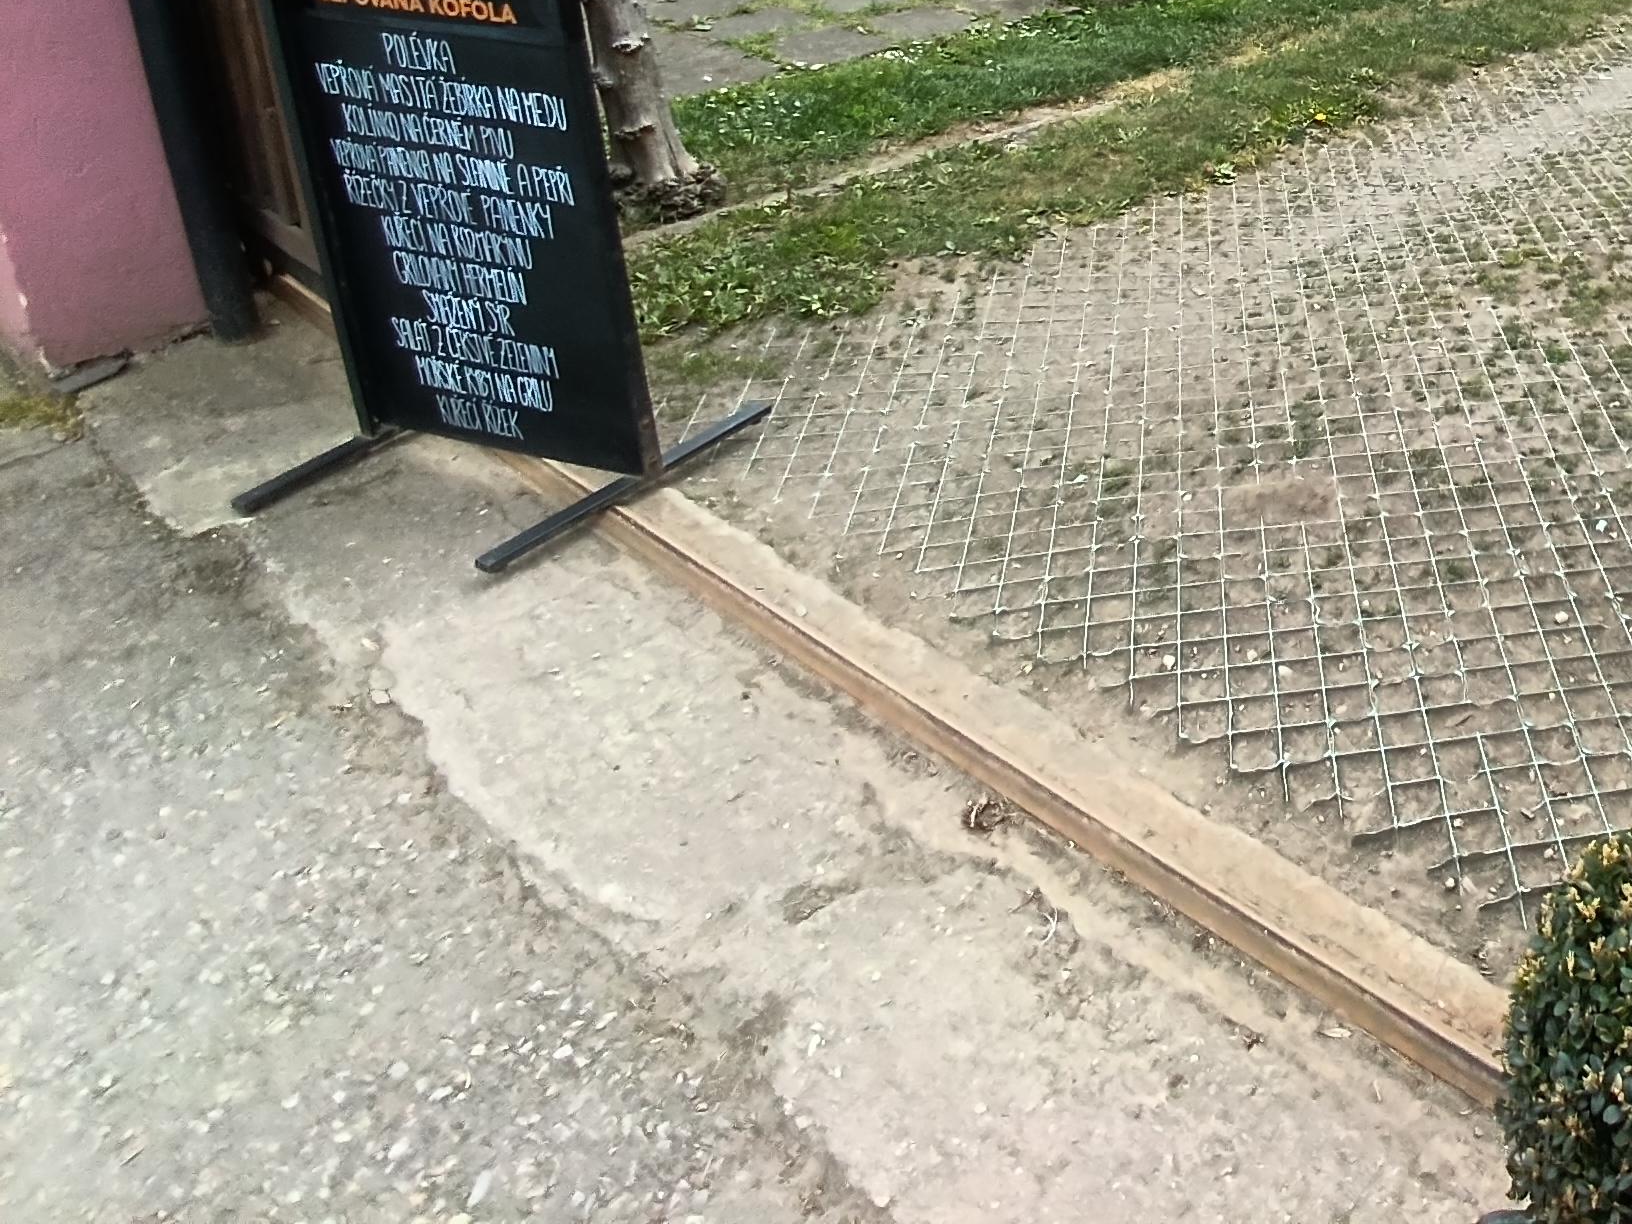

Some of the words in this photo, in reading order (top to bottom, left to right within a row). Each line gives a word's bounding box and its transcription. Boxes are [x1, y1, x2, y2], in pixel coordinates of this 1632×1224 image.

[380, 31, 456, 75] POLÉVKA
[378, 72, 440, 111] MASITÁ
[497, 86, 524, 124] NA
[522, 92, 568, 132] MEDU
[400, 113, 424, 144] NA
[481, 126, 514, 160] PIVU
[433, 154, 458, 185] NA
[517, 163, 533, 197] A
[398, 180, 412, 214] Z
[481, 193, 554, 239] PANENKY
[427, 224, 454, 255] NA
[485, 300, 516, 337] SÝR
[431, 325, 447, 357] Z
[495, 372, 518, 405] NA
